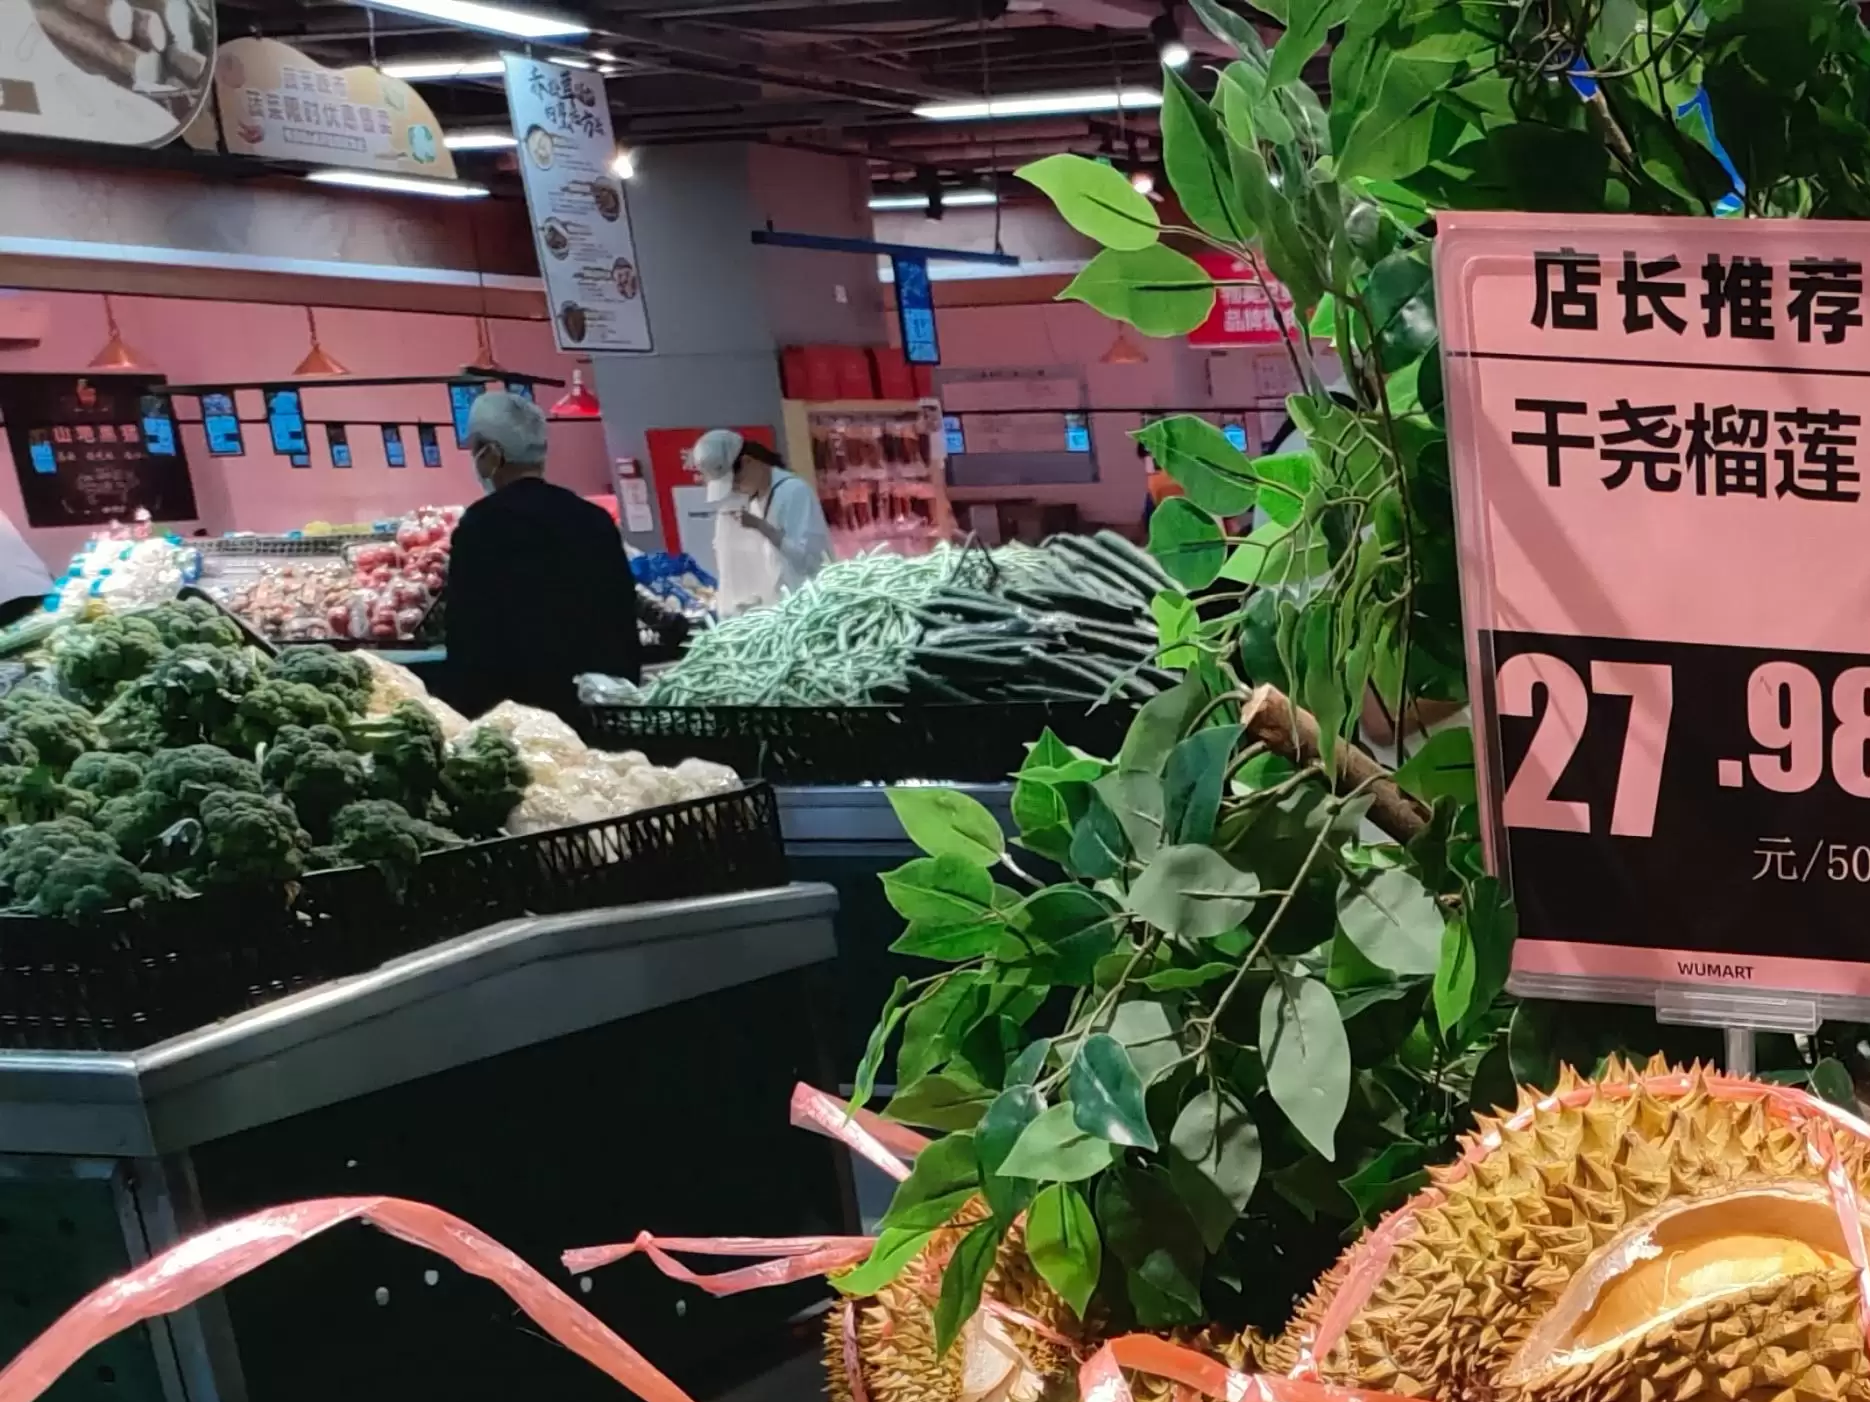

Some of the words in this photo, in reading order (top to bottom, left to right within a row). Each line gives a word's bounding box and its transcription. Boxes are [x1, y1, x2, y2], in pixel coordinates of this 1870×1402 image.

[1531, 247, 1863, 345] 店长推荐
[1511, 398, 1861, 503] 干尧榴莲
[1677, 961, 1756, 981] WUMART
